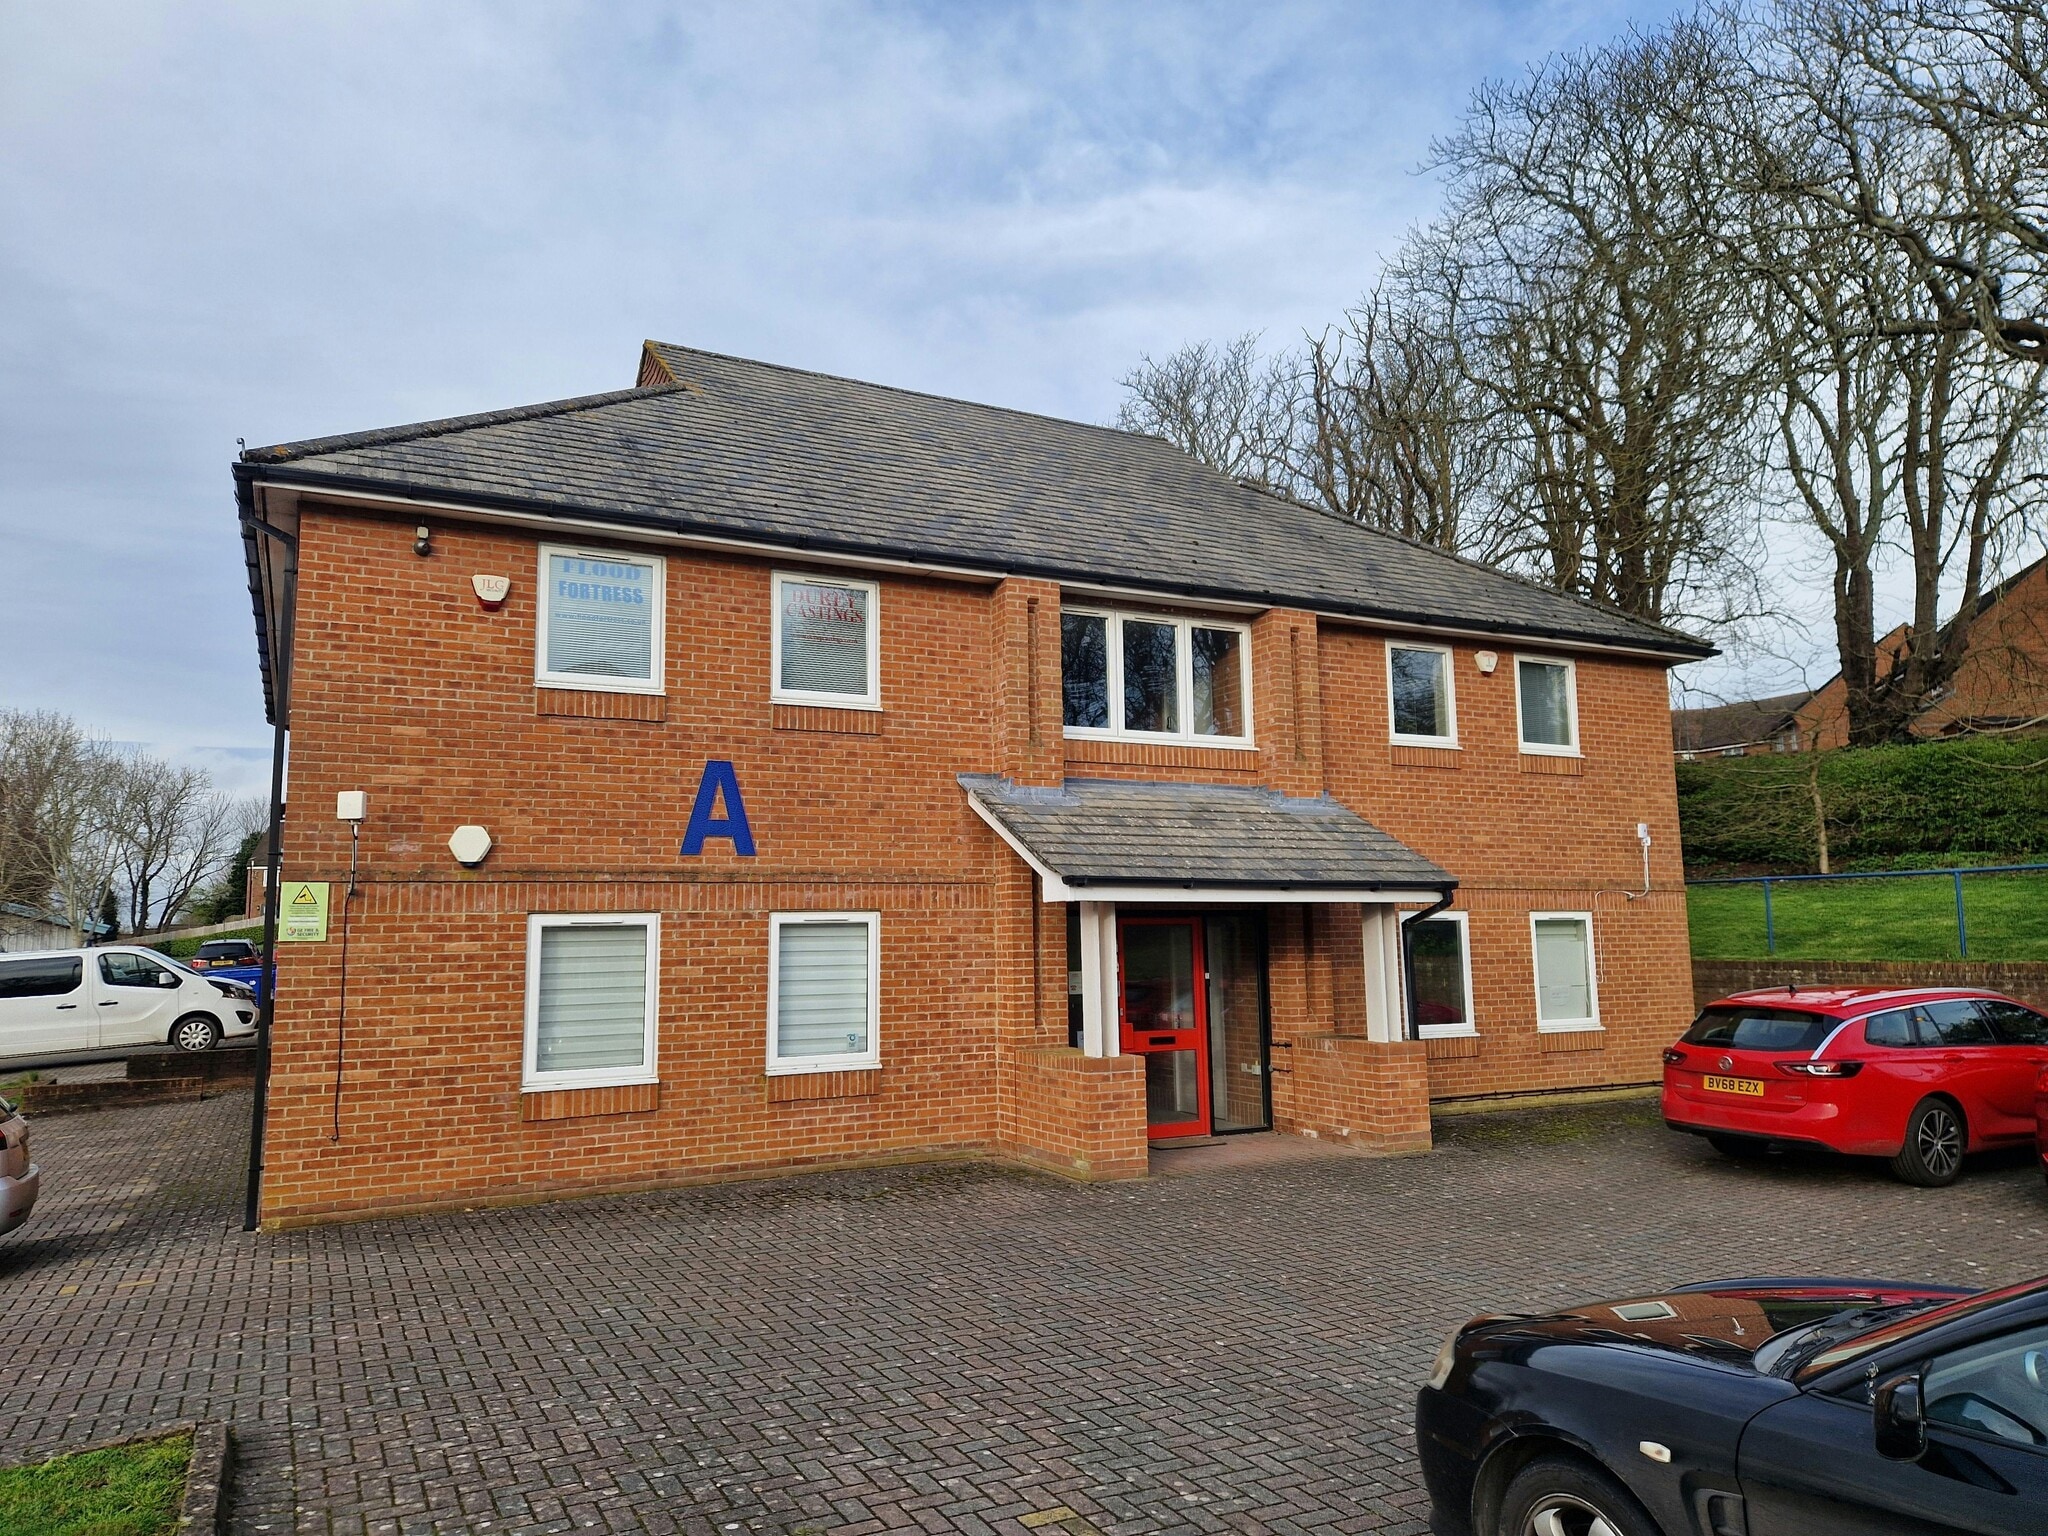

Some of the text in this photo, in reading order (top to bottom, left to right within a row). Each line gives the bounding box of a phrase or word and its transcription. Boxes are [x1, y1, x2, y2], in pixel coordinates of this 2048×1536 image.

[562, 559, 641, 580] FLOOD
[558, 580, 644, 604] FORTRESS
[787, 603, 864, 623] CASTINGS
[679, 760, 757, 857] A
[1708, 1077, 1759, 1093] BV68 EZX
